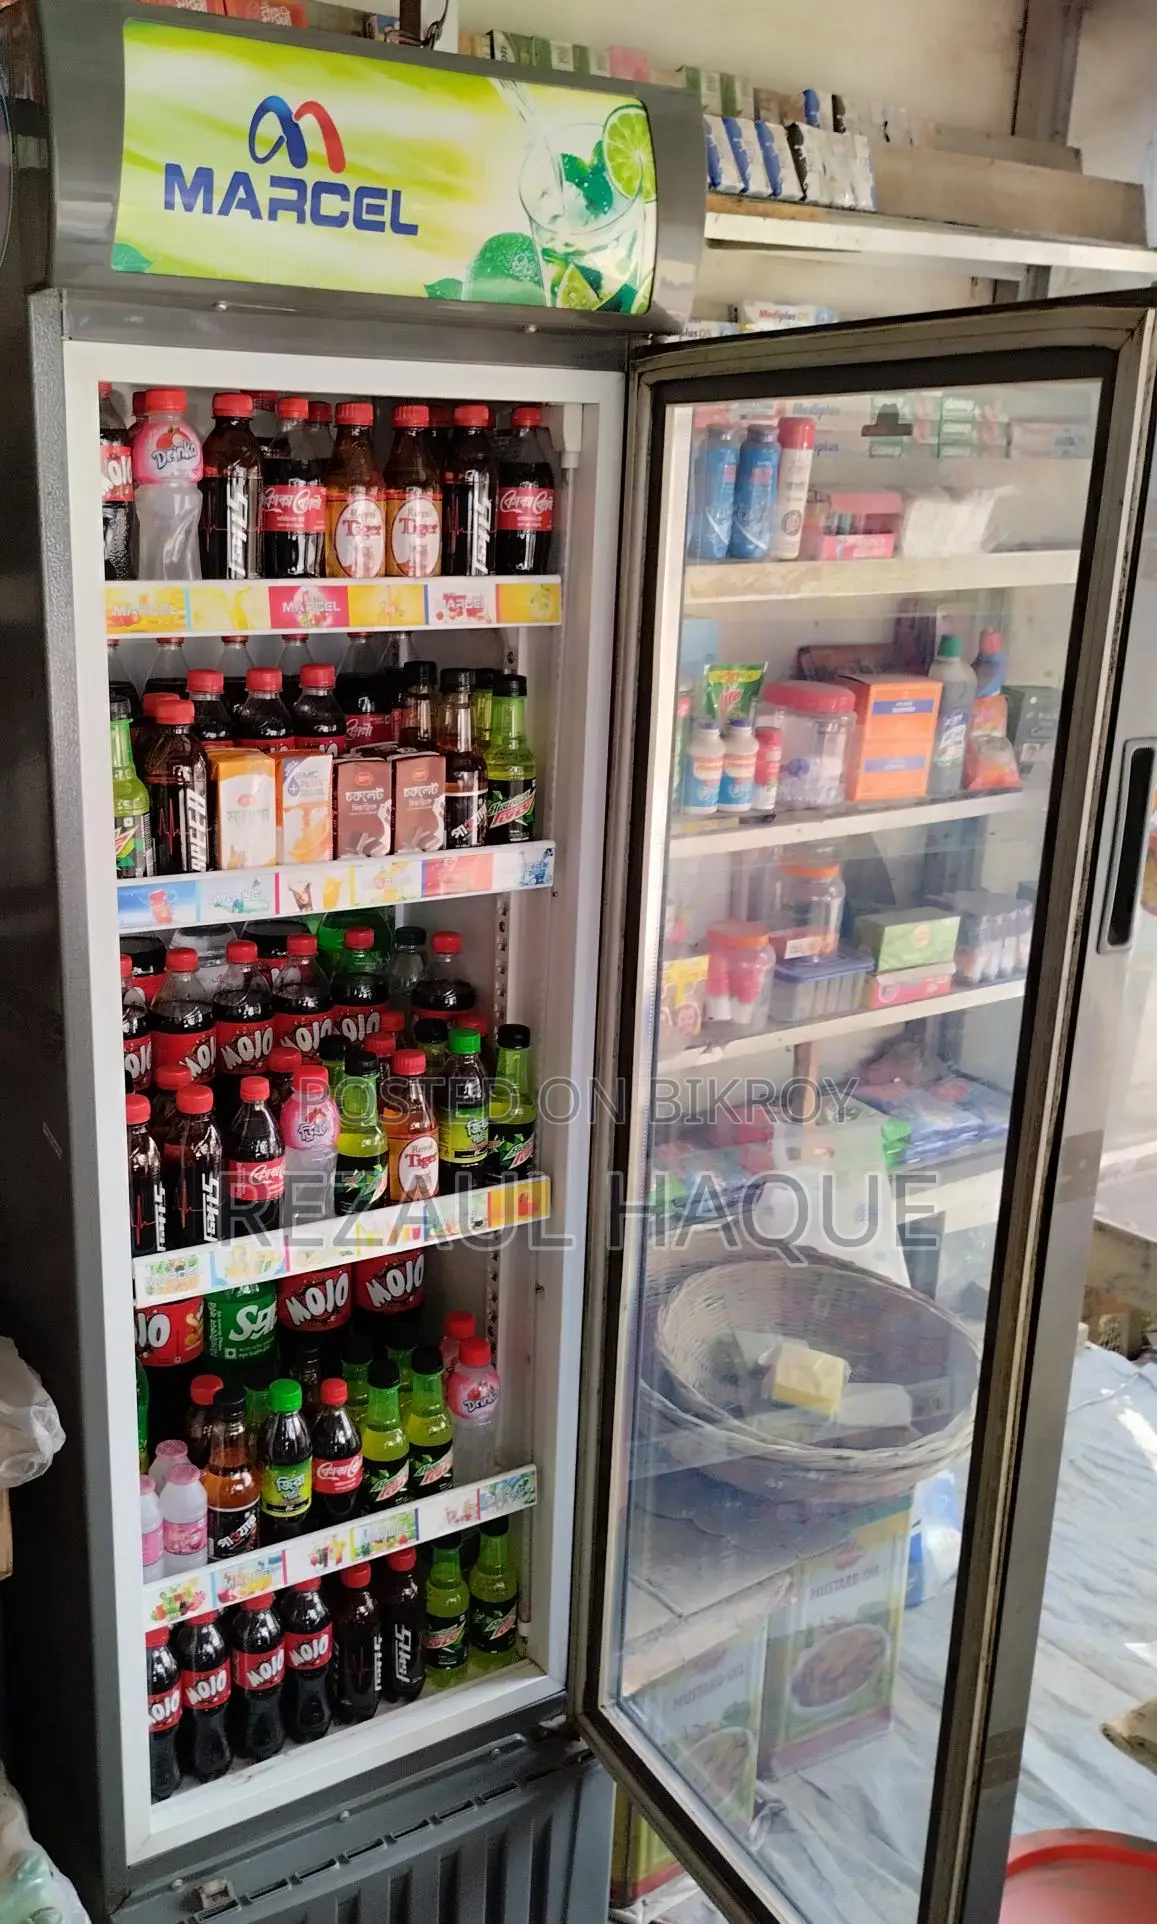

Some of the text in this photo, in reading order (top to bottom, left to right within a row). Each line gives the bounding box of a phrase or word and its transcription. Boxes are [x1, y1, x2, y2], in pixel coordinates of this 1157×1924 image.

[163, 163, 419, 236] MARCEL
[190, 788, 207, 871] SPEED
[221, 1027, 273, 1070] MOJO
[405, 1153, 437, 1169] Tiger
[285, 1272, 349, 1326] MOJO
[366, 1255, 424, 1308] MOJO
[247, 1648, 284, 1686] MOJO
[289, 1634, 328, 1666] MOJO
[185, 1670, 227, 1704] MOJO
